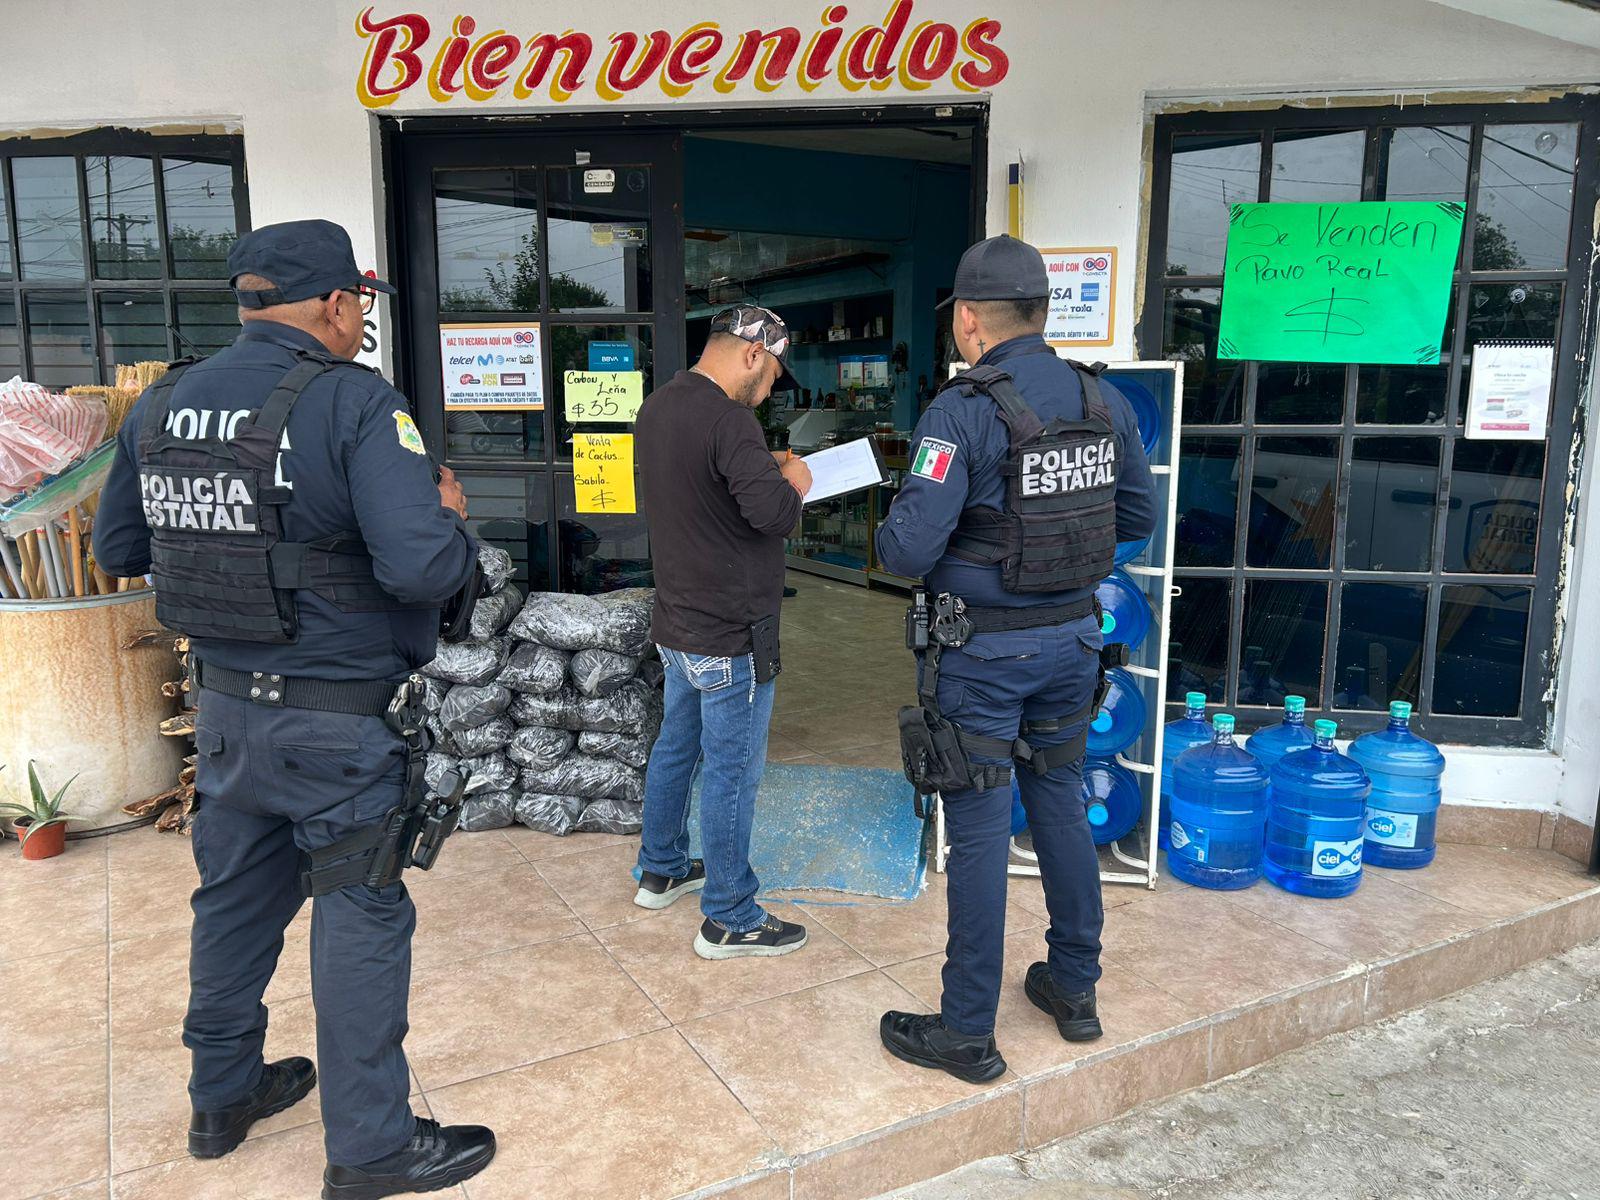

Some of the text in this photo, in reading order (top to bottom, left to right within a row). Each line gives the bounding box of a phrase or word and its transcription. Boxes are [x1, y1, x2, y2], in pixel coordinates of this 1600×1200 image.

[356, 0, 1008, 108] Bienvenidos
[1240, 206, 1437, 252] Se Venden
[1049, 261, 1080, 272] AQUÍ CON
[1235, 255, 1304, 285] Pavo
[1049, 288, 1073, 300] ISA
[458, 337, 464, 346] TU
[465, 337, 488, 346] RECARGA
[502, 336, 513, 345] CON
[449, 356, 475, 365] telcel
[597, 381, 627, 396] Leña
[586, 435, 612, 447] Venta
[922, 441, 952, 454] MEXICO
[575, 448, 585, 459] de
[1022, 438, 1115, 475] POLICÍA
[1022, 464, 1115, 496] ESTATAL
[140, 472, 254, 505] POLICÍA
[142, 499, 256, 532] ESTATAL
[1371, 821, 1393, 834] ciel
[1318, 852, 1341, 864] ciel
